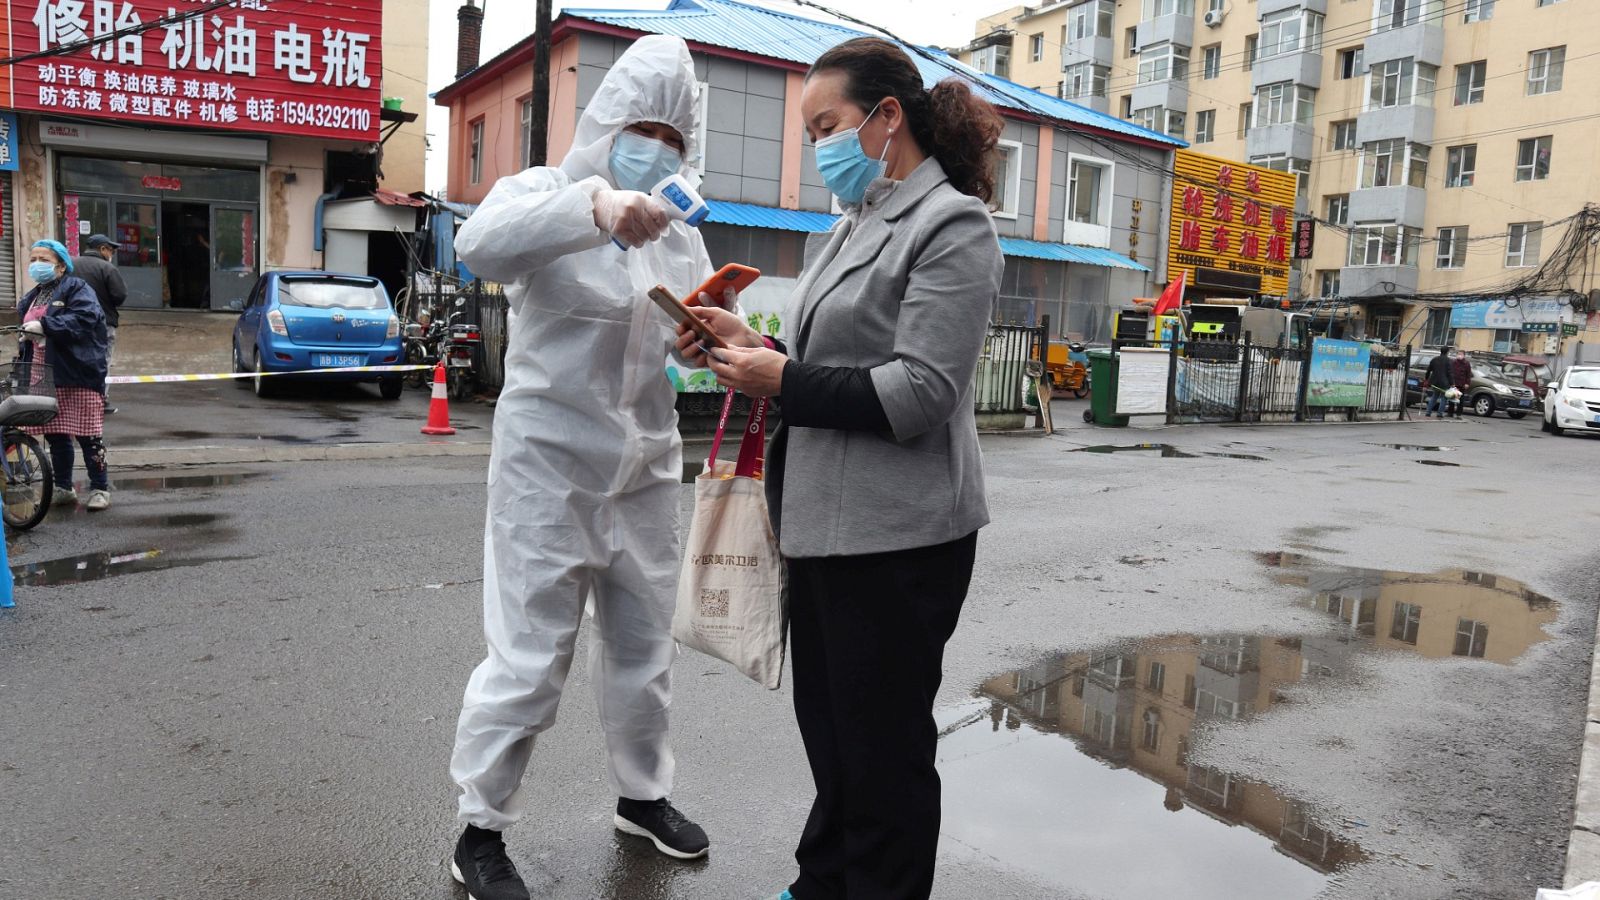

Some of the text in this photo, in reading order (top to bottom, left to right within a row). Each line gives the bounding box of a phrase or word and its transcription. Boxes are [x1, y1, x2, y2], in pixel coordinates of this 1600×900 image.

[33, 0, 371, 88] 修胎 机油 电瓶
[38, 63, 237, 101] 动平衡 换油保养 玻璃水
[39, 86, 239, 123] 防冻液 微型配件 机修
